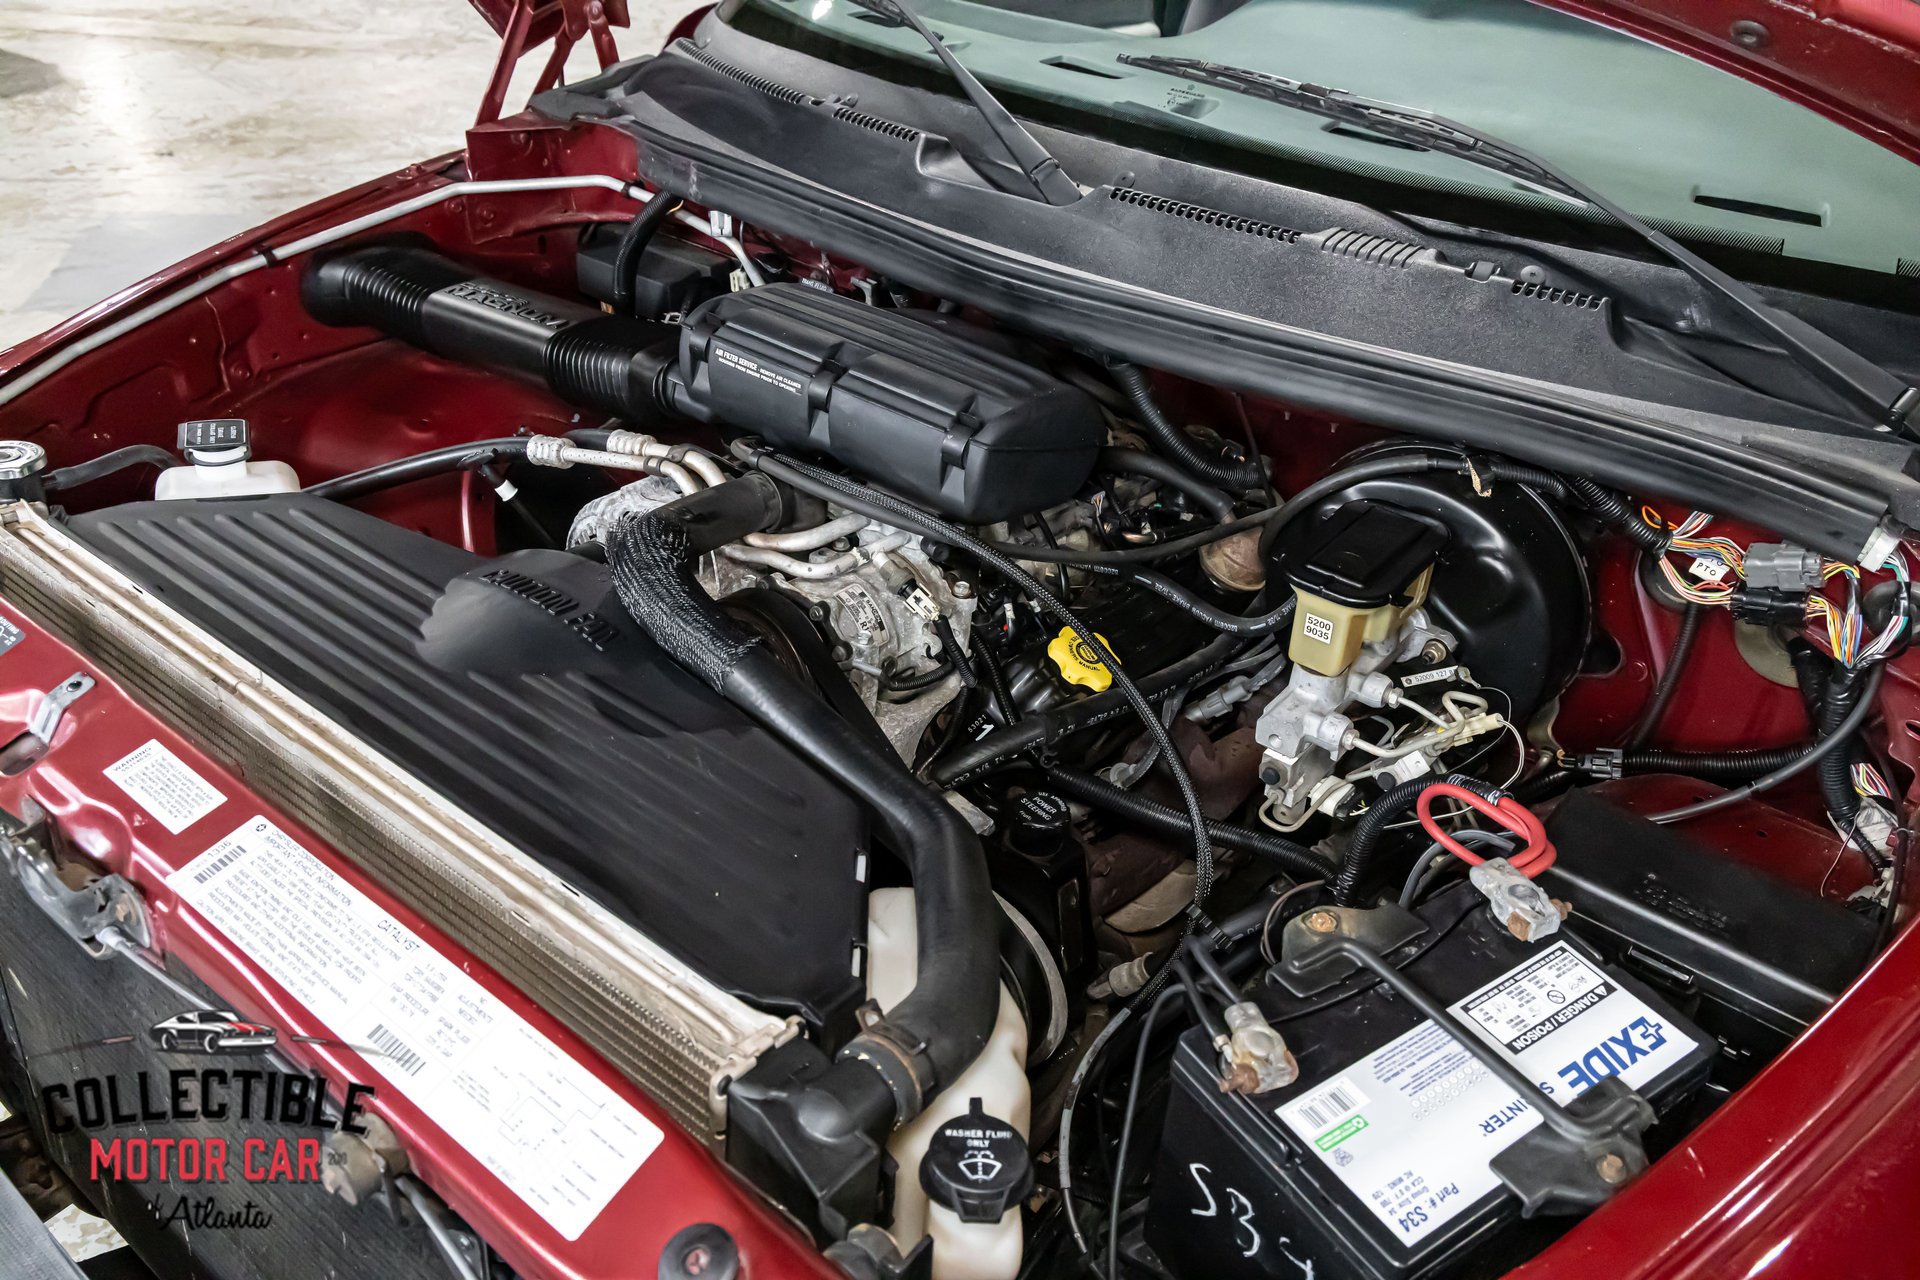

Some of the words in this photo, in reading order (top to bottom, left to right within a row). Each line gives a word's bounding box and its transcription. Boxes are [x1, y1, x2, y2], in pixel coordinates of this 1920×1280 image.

[445, 287, 569, 328] MAGNUM
[715, 348, 724, 358] AIR
[723, 350, 739, 362] FILTER
[738, 355, 758, 371] SERVICE
[760, 368, 776, 380] REMOVE
[783, 375, 802, 389] CLEANER
[718, 357, 735, 369] HOUSING
[735, 363, 747, 373] FROM
[746, 366, 761, 378] ENGINE
[761, 372, 773, 383] PRIOR
[1696, 562, 1717, 577] PTO
[1306, 625, 1330, 640] 9035
[1307, 616, 1331, 632] 5200
[1079, 660, 1100, 671] MANUAL
[1414, 671, 1435, 683] 52009
[1435, 669, 1448, 680] 127
[967, 714, 987, 734] 53021
[1020, 797, 1053, 822] STEERING
[1032, 796, 1056, 814] POWER
[316, 874, 352, 907] INFORMATION
[377, 919, 421, 953] CATALYST
[1560, 993, 1599, 1025] DANGER
[1512, 1021, 1551, 1052] POISON
[1558, 1016, 1668, 1098] EXIDE
[944, 1129, 984, 1139] WASHER
[985, 1129, 1013, 1140] FLUID
[966, 1139, 990, 1148] ONLY
[1438, 1183, 1459, 1202] Part
[1398, 1201, 1430, 1233] S34
